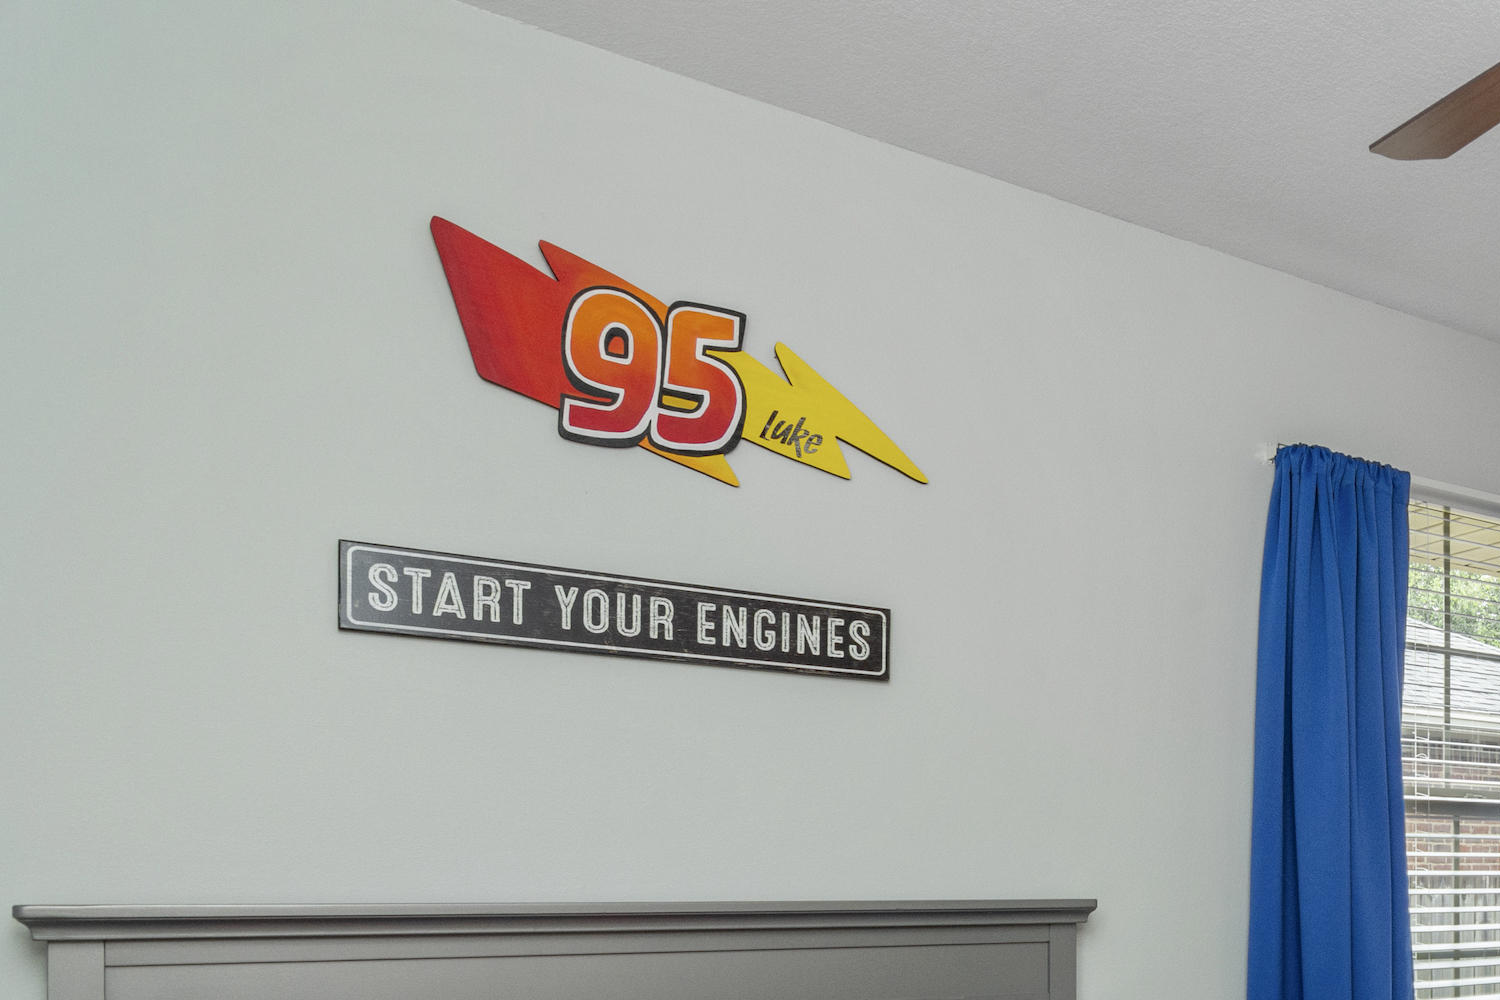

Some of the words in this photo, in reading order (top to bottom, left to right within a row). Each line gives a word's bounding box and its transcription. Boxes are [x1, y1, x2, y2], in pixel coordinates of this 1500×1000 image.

[558, 285, 747, 457] 95
[760, 410, 823, 458] Luke
[366, 562, 531, 625] START
[554, 584, 674, 641] YOUR
[696, 601, 872, 662] ENGINES
